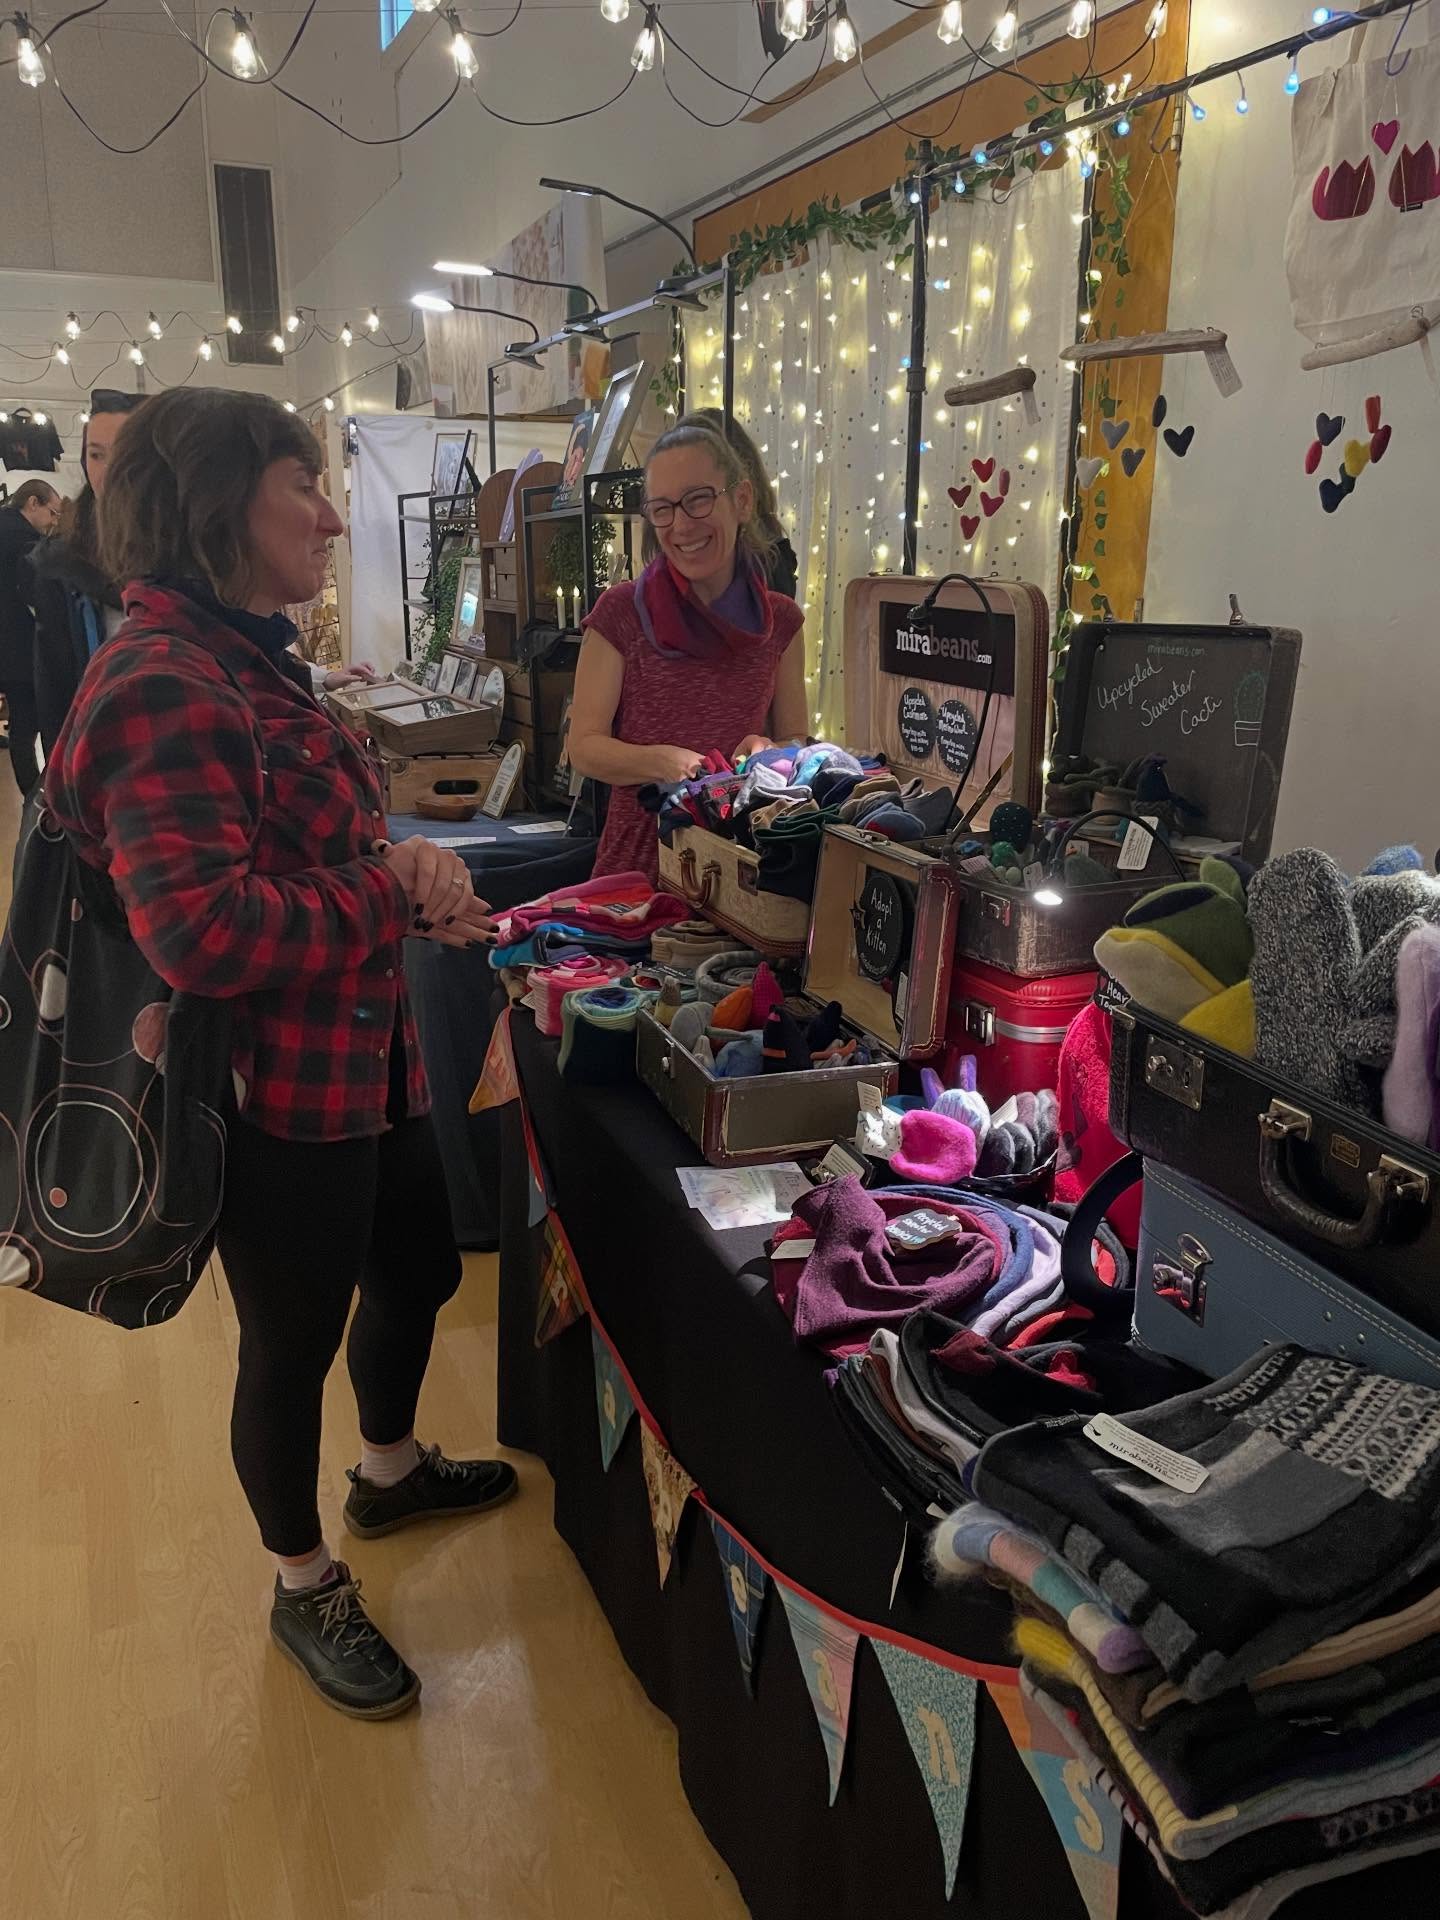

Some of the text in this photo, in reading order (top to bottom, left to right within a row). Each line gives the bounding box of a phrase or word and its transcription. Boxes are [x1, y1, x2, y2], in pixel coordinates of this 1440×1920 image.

[1097, 658, 1163, 711] Upcycled
[1140, 670, 1196, 727] Sweater
[1180, 696, 1222, 735] Cacti
[870, 887, 893, 922] Adopt
[865, 926, 887, 955] Kitten
[876, 918, 882, 929] a
